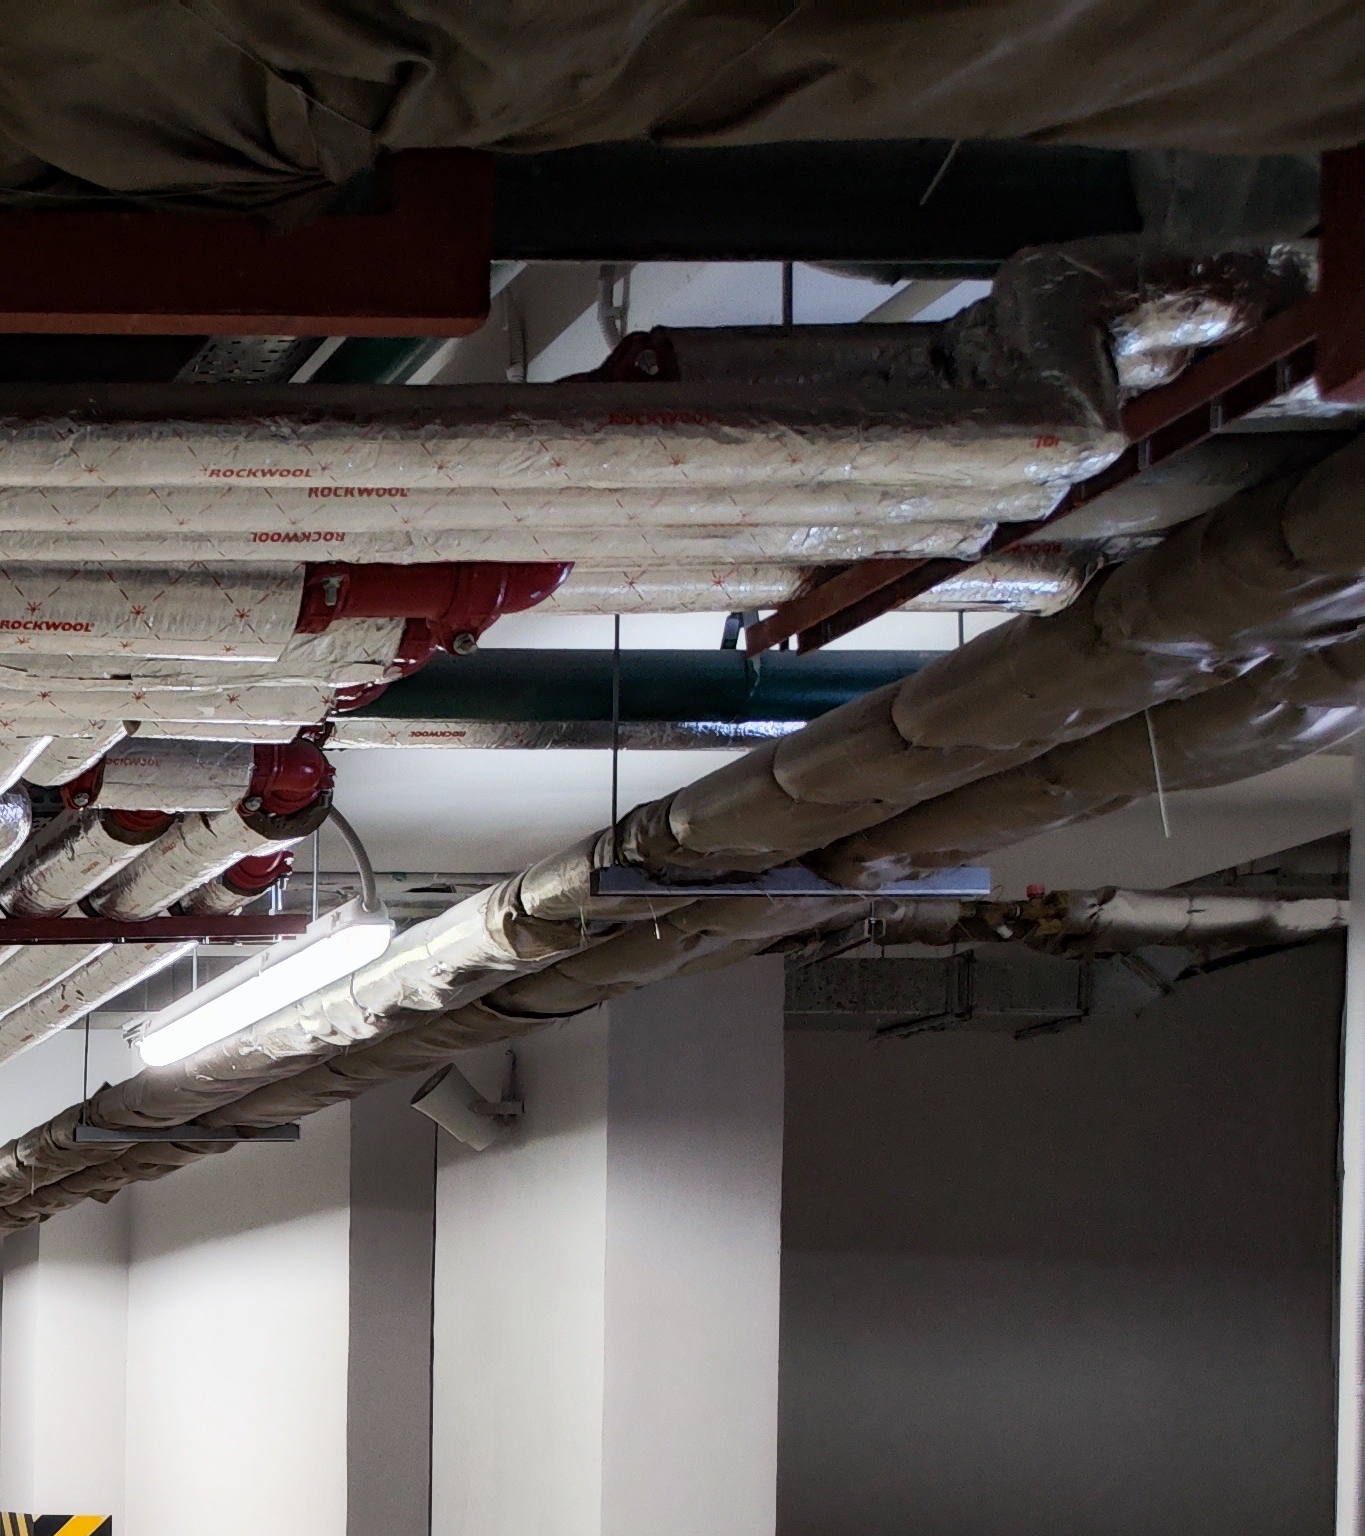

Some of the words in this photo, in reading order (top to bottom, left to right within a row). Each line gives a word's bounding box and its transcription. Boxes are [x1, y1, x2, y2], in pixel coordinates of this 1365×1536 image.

[208, 468, 312, 478] ROCKWOOL
[308, 487, 408, 498] ROCKWOOL
[251, 532, 345, 543] ROCKWOOL
[0, 620, 94, 633] ROCKWOOL
[409, 730, 466, 738] ROCKWOOL
[106, 757, 160, 768] OCKWOOL
